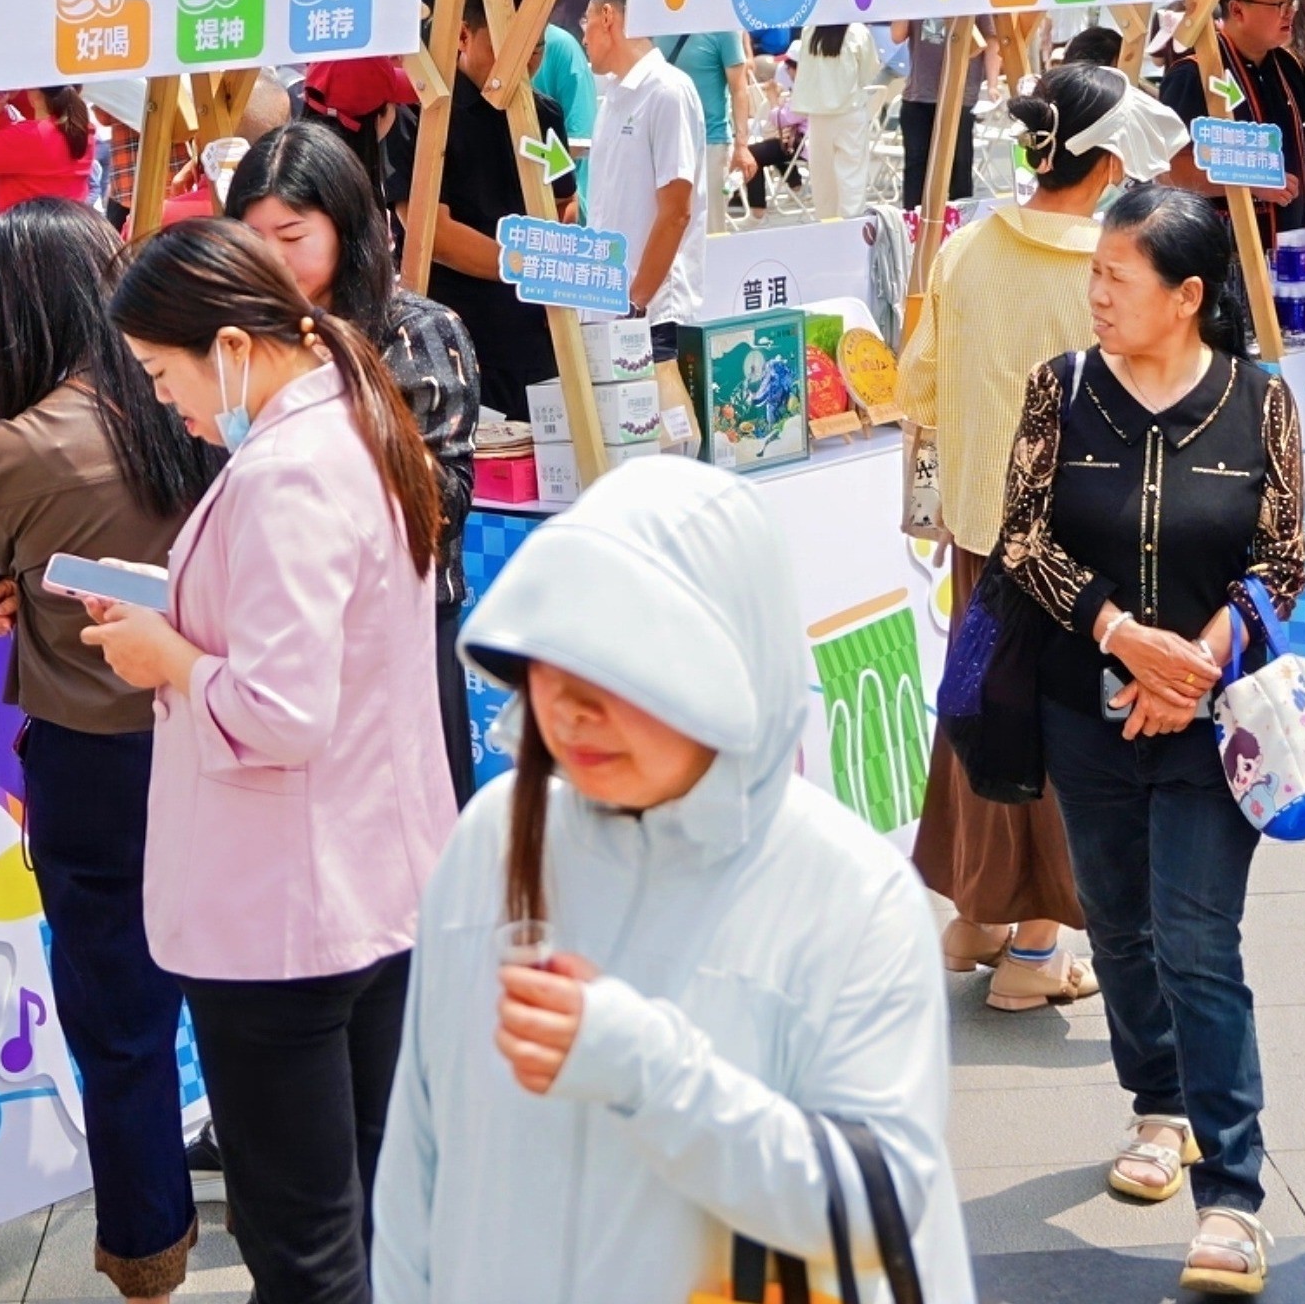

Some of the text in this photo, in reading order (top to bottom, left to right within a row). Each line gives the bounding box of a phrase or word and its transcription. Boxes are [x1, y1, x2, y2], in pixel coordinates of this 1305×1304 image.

[195, 17, 245, 51] 提神
[307, 7, 355, 41] 推荐
[75, 25, 129, 60] 好喝
[1199, 125, 1269, 148] 中国咖啡之都
[508, 225, 611, 260] 中国咖啡之都
[522, 255, 624, 291] 普洱咖香市集
[743, 277, 788, 310] 普洱
